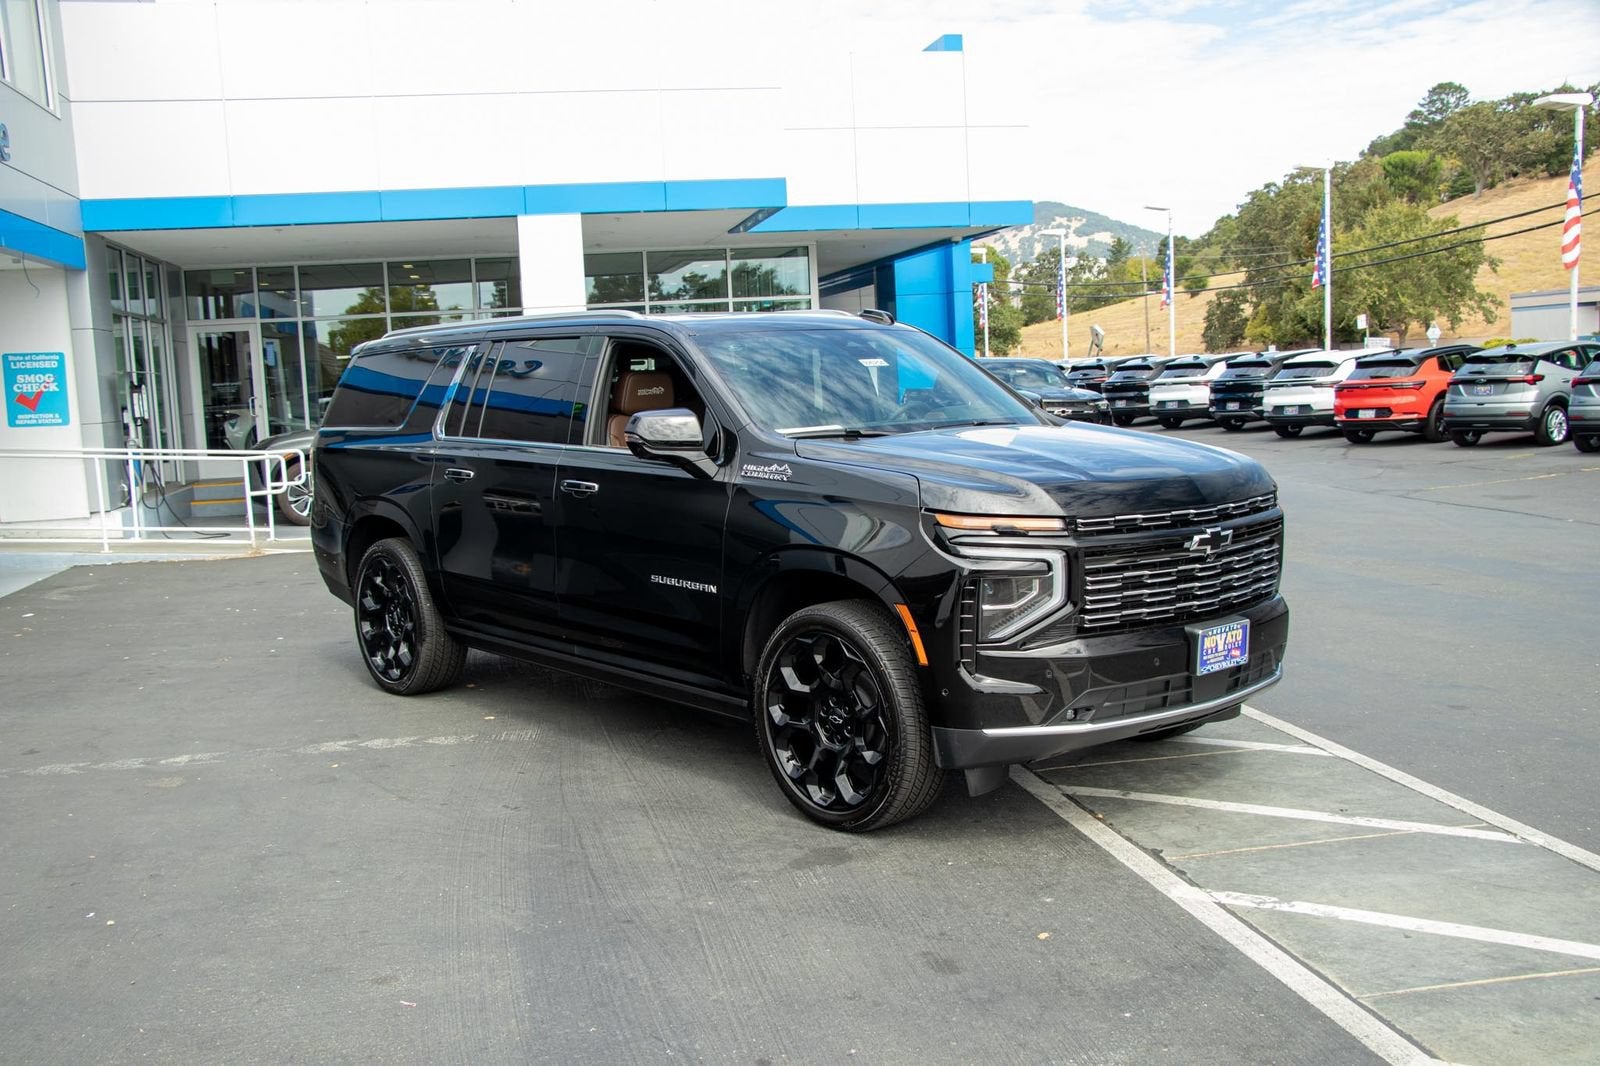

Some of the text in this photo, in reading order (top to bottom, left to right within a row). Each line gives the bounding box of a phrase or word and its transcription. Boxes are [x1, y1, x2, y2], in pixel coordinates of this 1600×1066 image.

[10, 361, 58, 369] LICENSED
[16, 373, 55, 384] SMOG
[13, 382, 59, 393] CHECK
[650, 574, 717, 594] SUBURBAN
[1203, 629, 1242, 651] NOVATO
